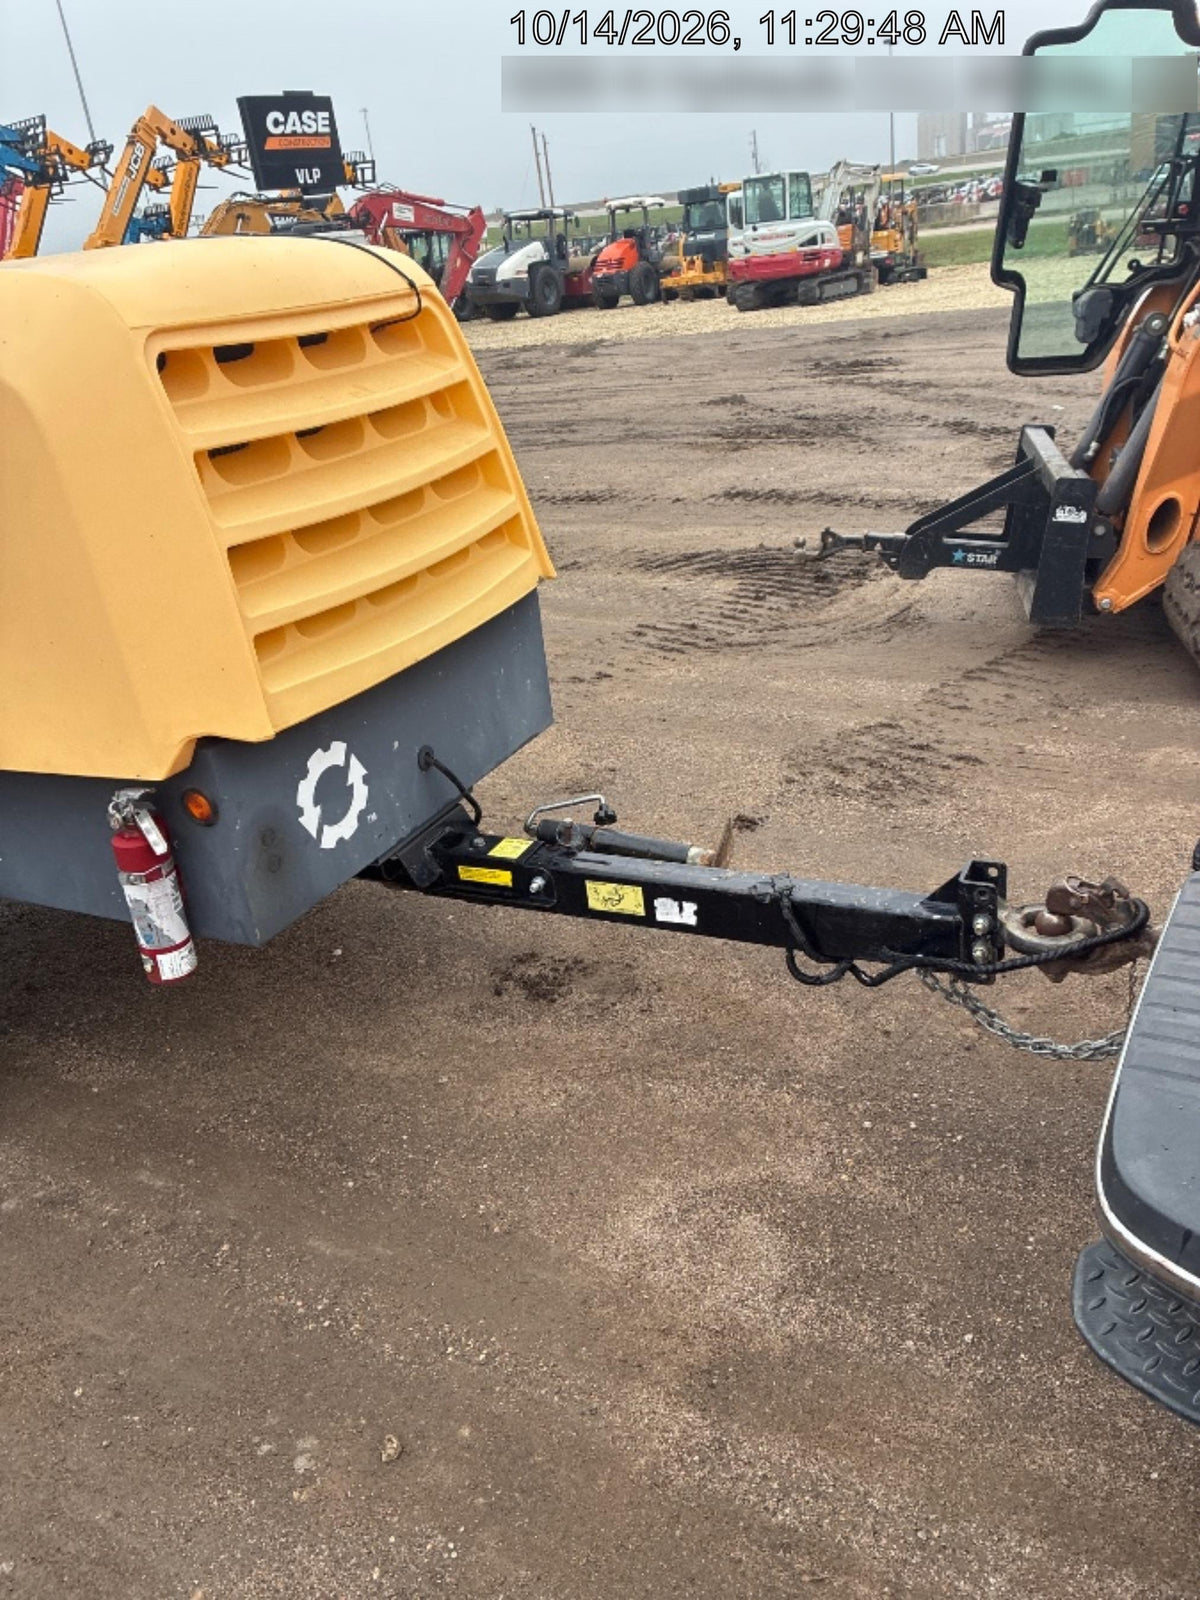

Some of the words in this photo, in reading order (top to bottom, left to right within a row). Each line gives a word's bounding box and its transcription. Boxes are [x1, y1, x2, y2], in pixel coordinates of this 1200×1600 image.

[265, 110, 330, 134] CASE
[129, 142, 145, 179] JCB
[295, 168, 321, 184] VLP
[967, 553, 998, 565] STAR
